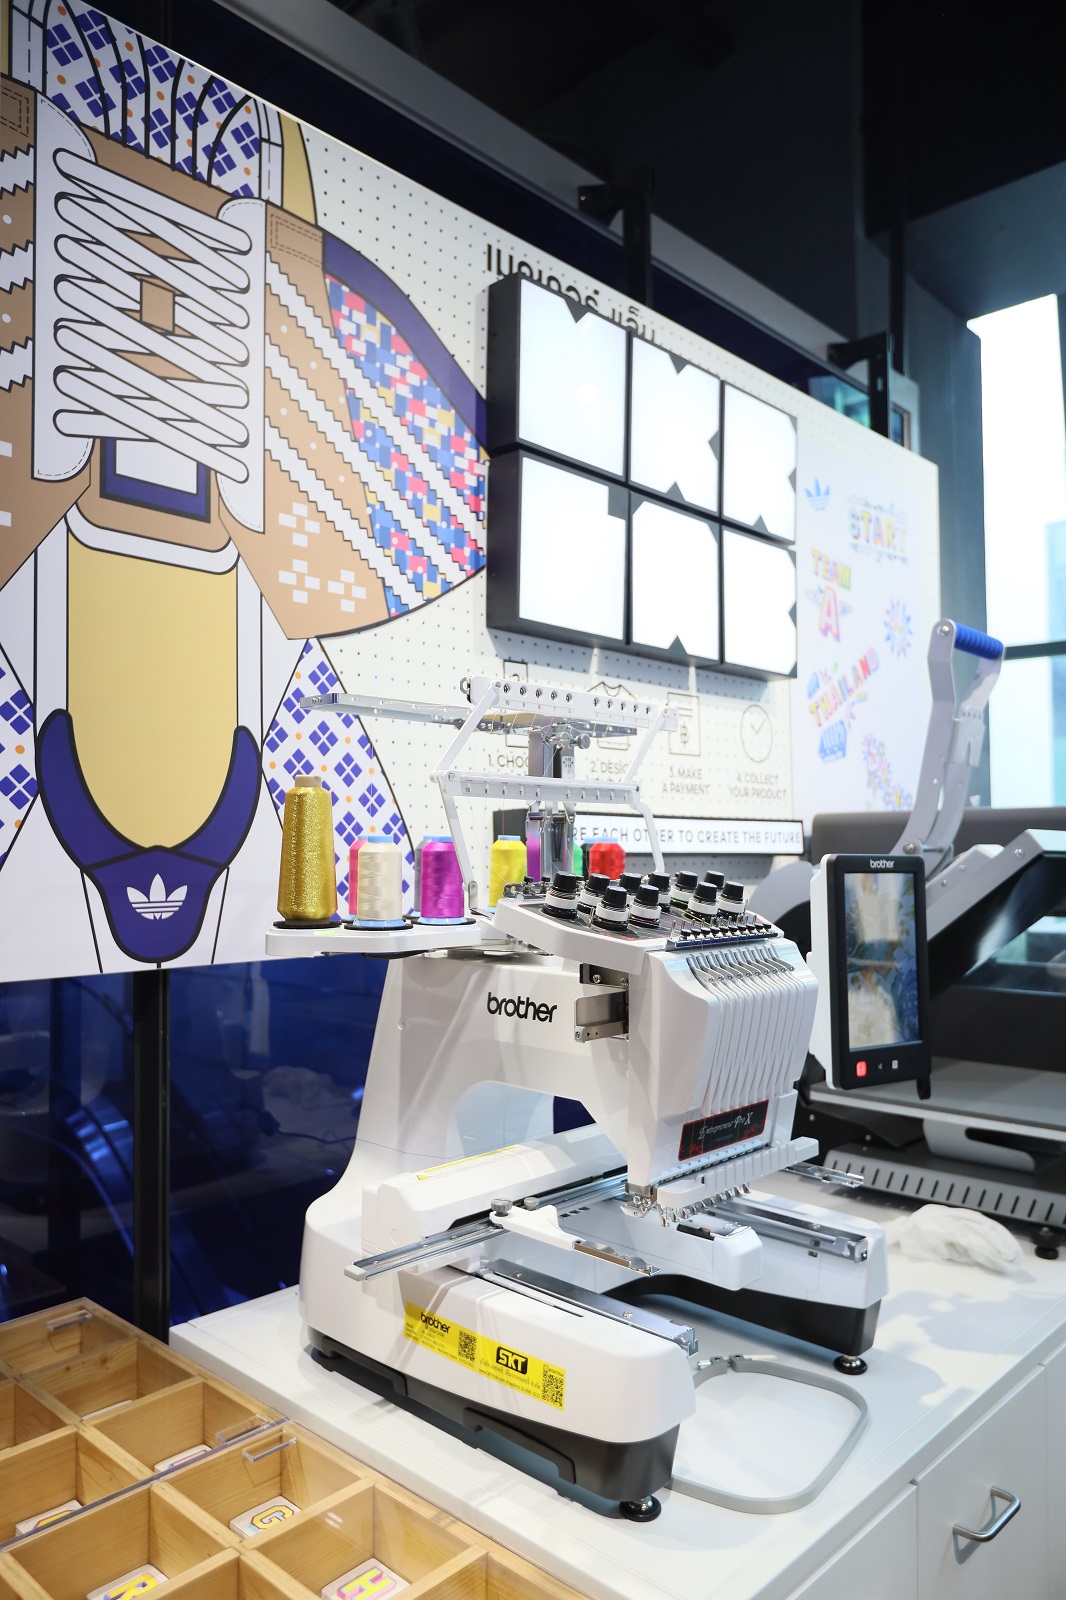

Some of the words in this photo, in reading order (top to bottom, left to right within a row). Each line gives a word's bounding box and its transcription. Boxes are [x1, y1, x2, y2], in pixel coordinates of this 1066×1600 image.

[812, 548, 851, 592] TEAM
[809, 646, 880, 727] THAILAND
[497, 754, 529, 769] CHO
[677, 766, 702, 780] MAKE
[744, 772, 779, 786] COLLECT
[669, 783, 711, 796] PAYMENT
[593, 828, 628, 842] EACH
[634, 828, 674, 842] OTER
[679, 830, 694, 842] TO
[697, 830, 739, 844] CREATE
[742, 831, 762, 844] THE
[764, 831, 800, 844] FUTURE
[870, 859, 894, 868] brother
[487, 992, 558, 1022] brother
[420, 1310, 450, 1334] brother
[498, 1348, 526, 1372] SKT
[251, 1505, 294, 1529] G
